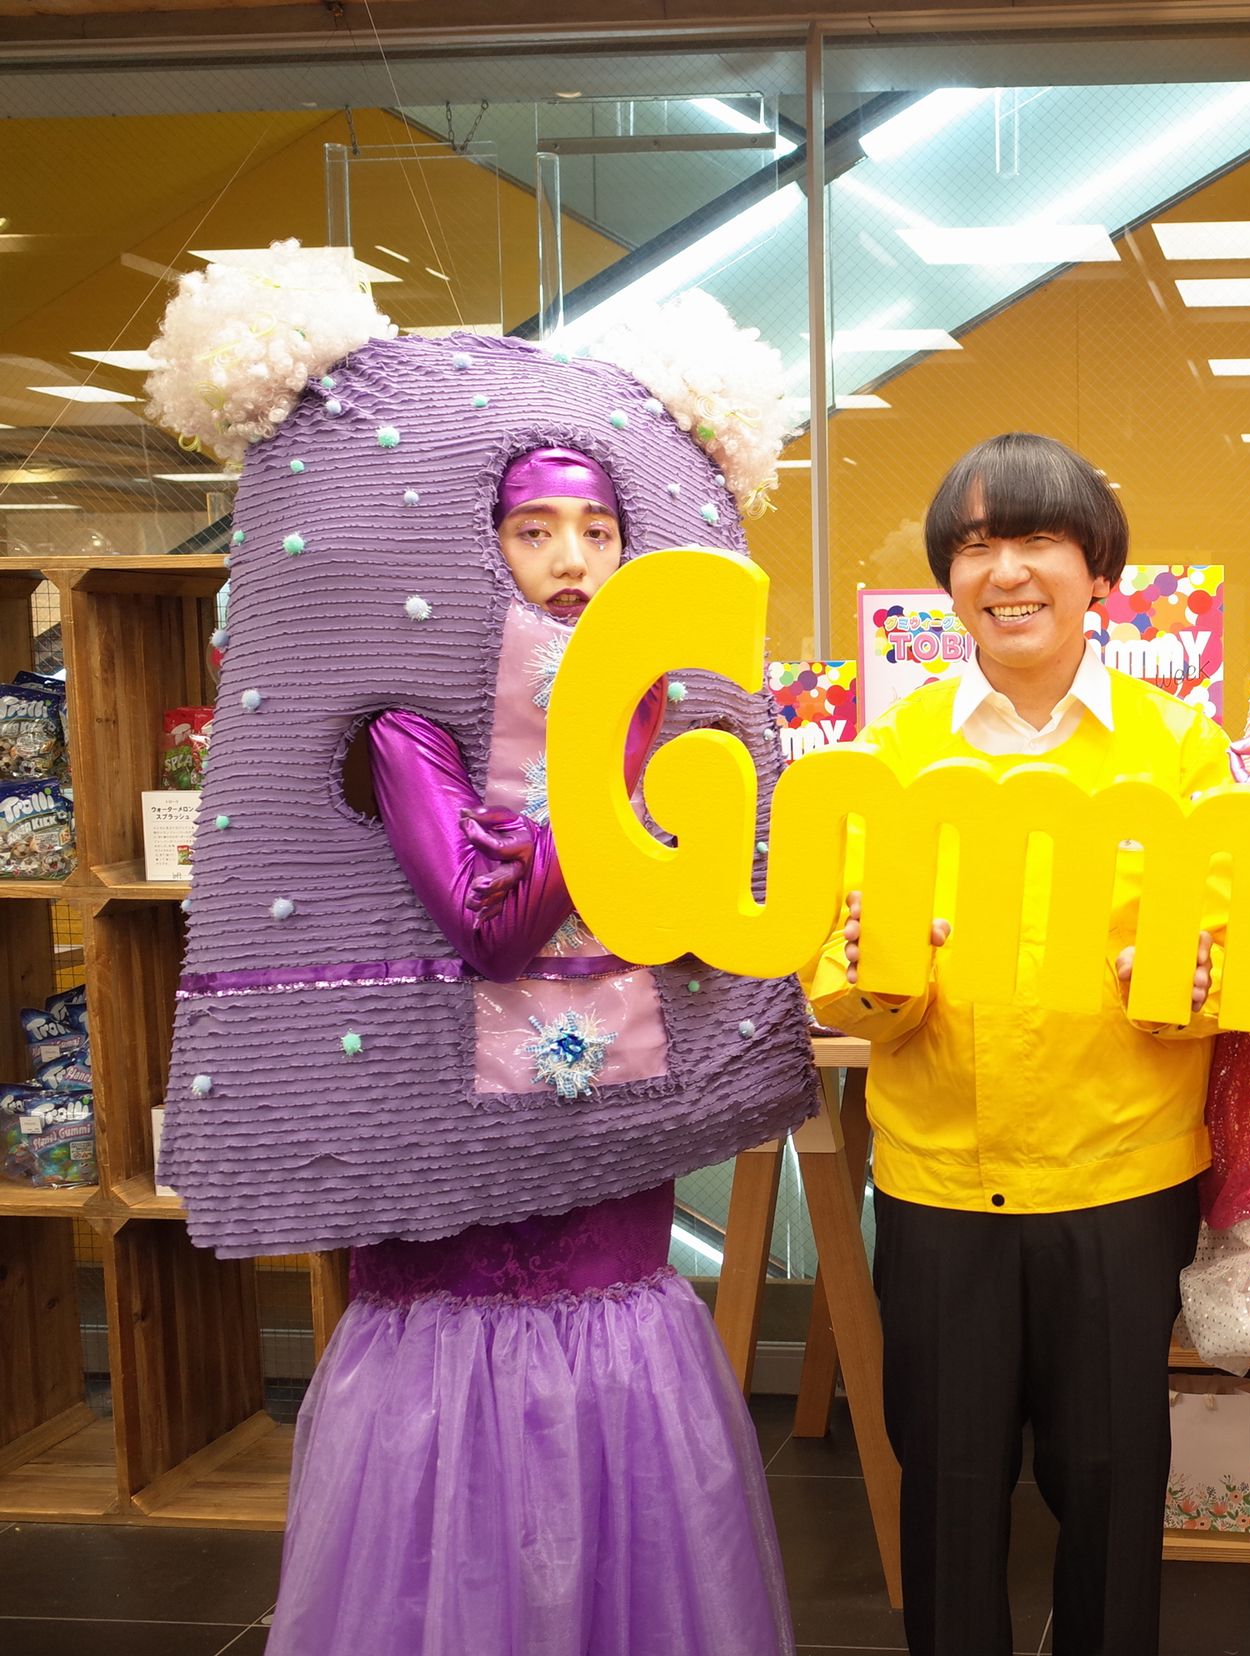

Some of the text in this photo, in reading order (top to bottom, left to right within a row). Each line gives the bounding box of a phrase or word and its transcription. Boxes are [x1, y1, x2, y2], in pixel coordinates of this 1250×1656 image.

[0, 696, 52, 720] Trolli
[0, 787, 55, 823] Trolli
[31, 1097, 90, 1128] Trolli
